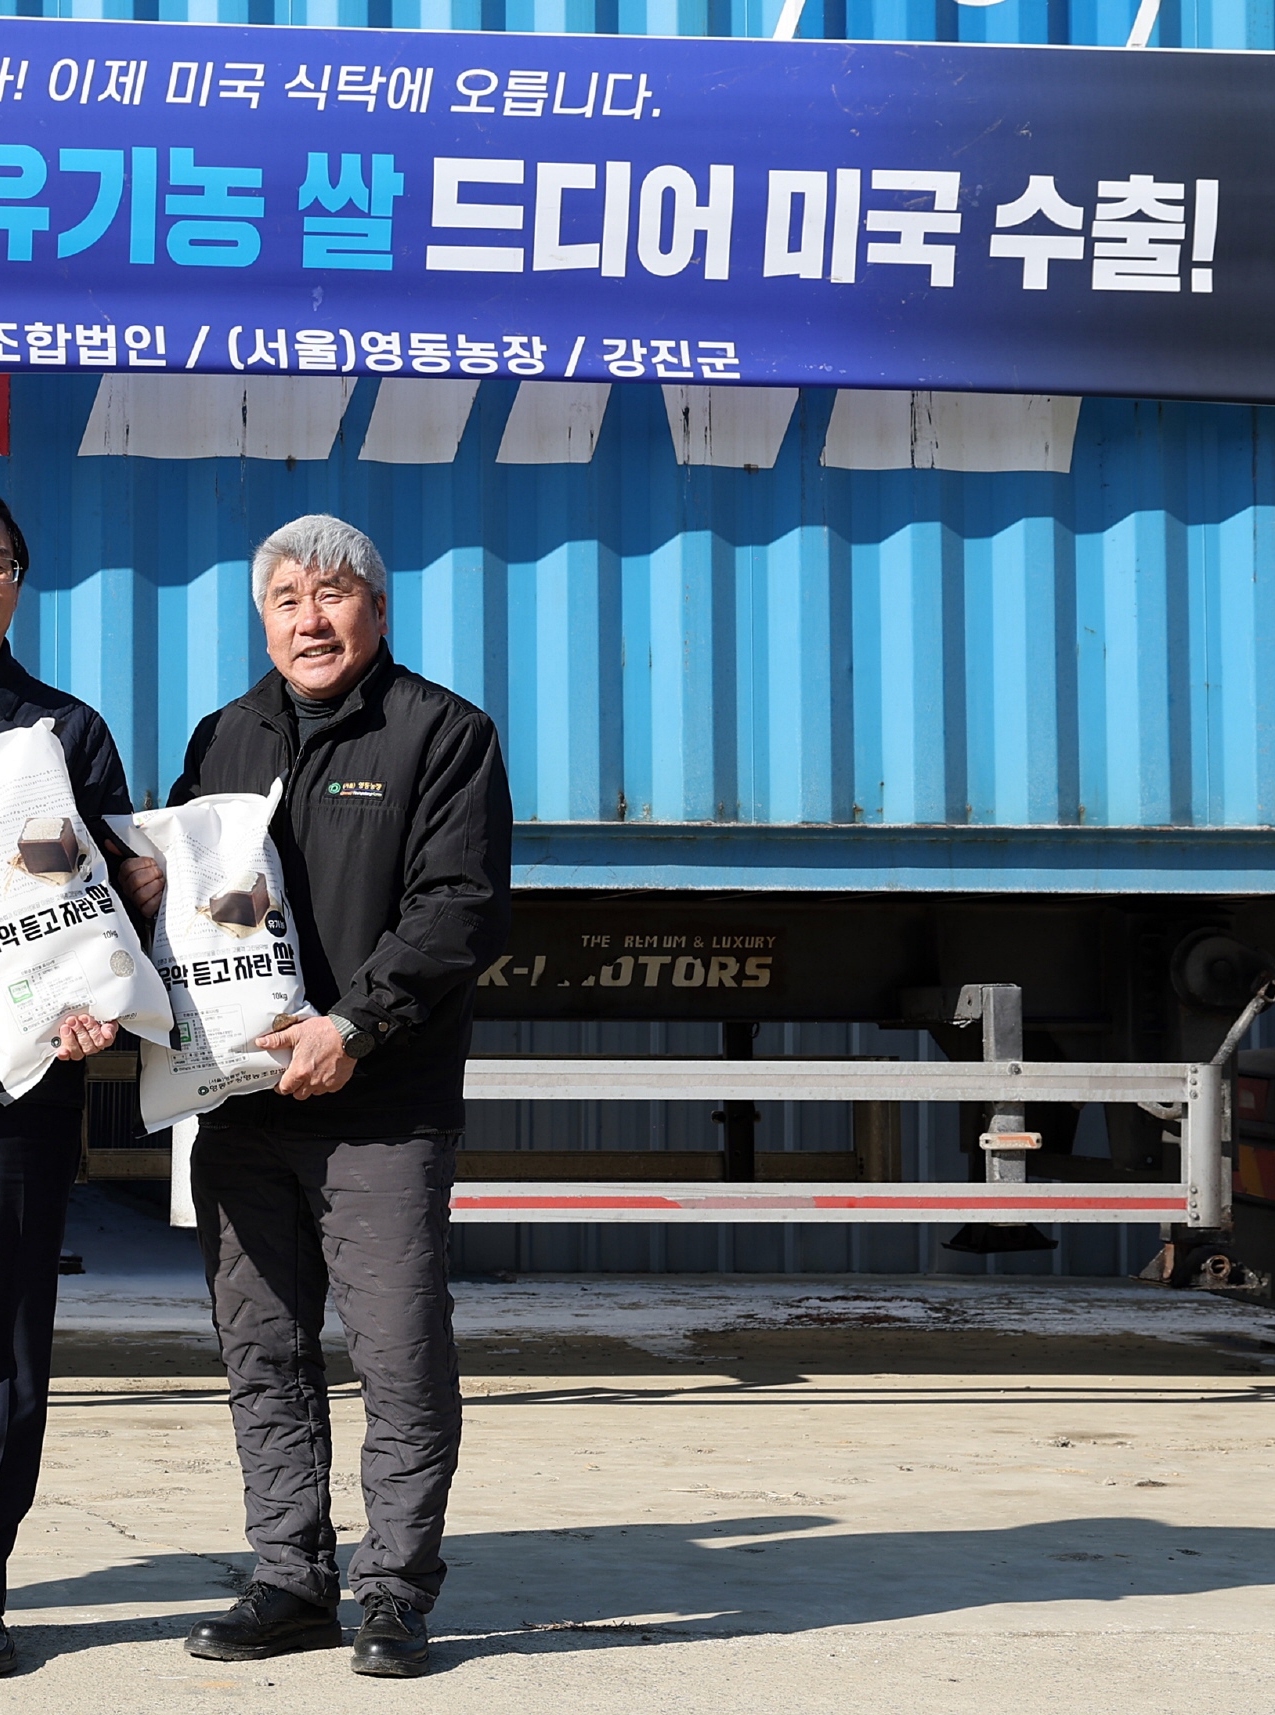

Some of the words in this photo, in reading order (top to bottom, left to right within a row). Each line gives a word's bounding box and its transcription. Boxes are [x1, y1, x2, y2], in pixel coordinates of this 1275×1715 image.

[48, 58, 148, 106] 이제
[165, 61, 265, 109] 미국
[284, 64, 434, 113] 식탁에
[450, 68, 662, 120] 오릅니다.
[298, 151, 405, 271] 쌀
[425, 157, 734, 280] 드디어
[763, 168, 962, 287] 미국
[989, 174, 1219, 293] 수출!
[185, 325, 210, 370] /
[228, 325, 547, 377] (서울)영동농장
[564, 336, 586, 378] /
[602, 338, 741, 380] 강진군
[19, 907, 61, 942] 듣고
[58, 897, 98, 928] 자란
[85, 883, 116, 914] 쌀
[157, 964, 189, 992] 음악
[192, 958, 231, 986] 듣고
[233, 953, 273, 981] 자란
[272, 942, 297, 976] 쌀
[581, 934, 611, 948] THE
[711, 935, 777, 949] LUXURY
[272, 992, 288, 1001] 10kg
[556, 955, 774, 988] OTORS
